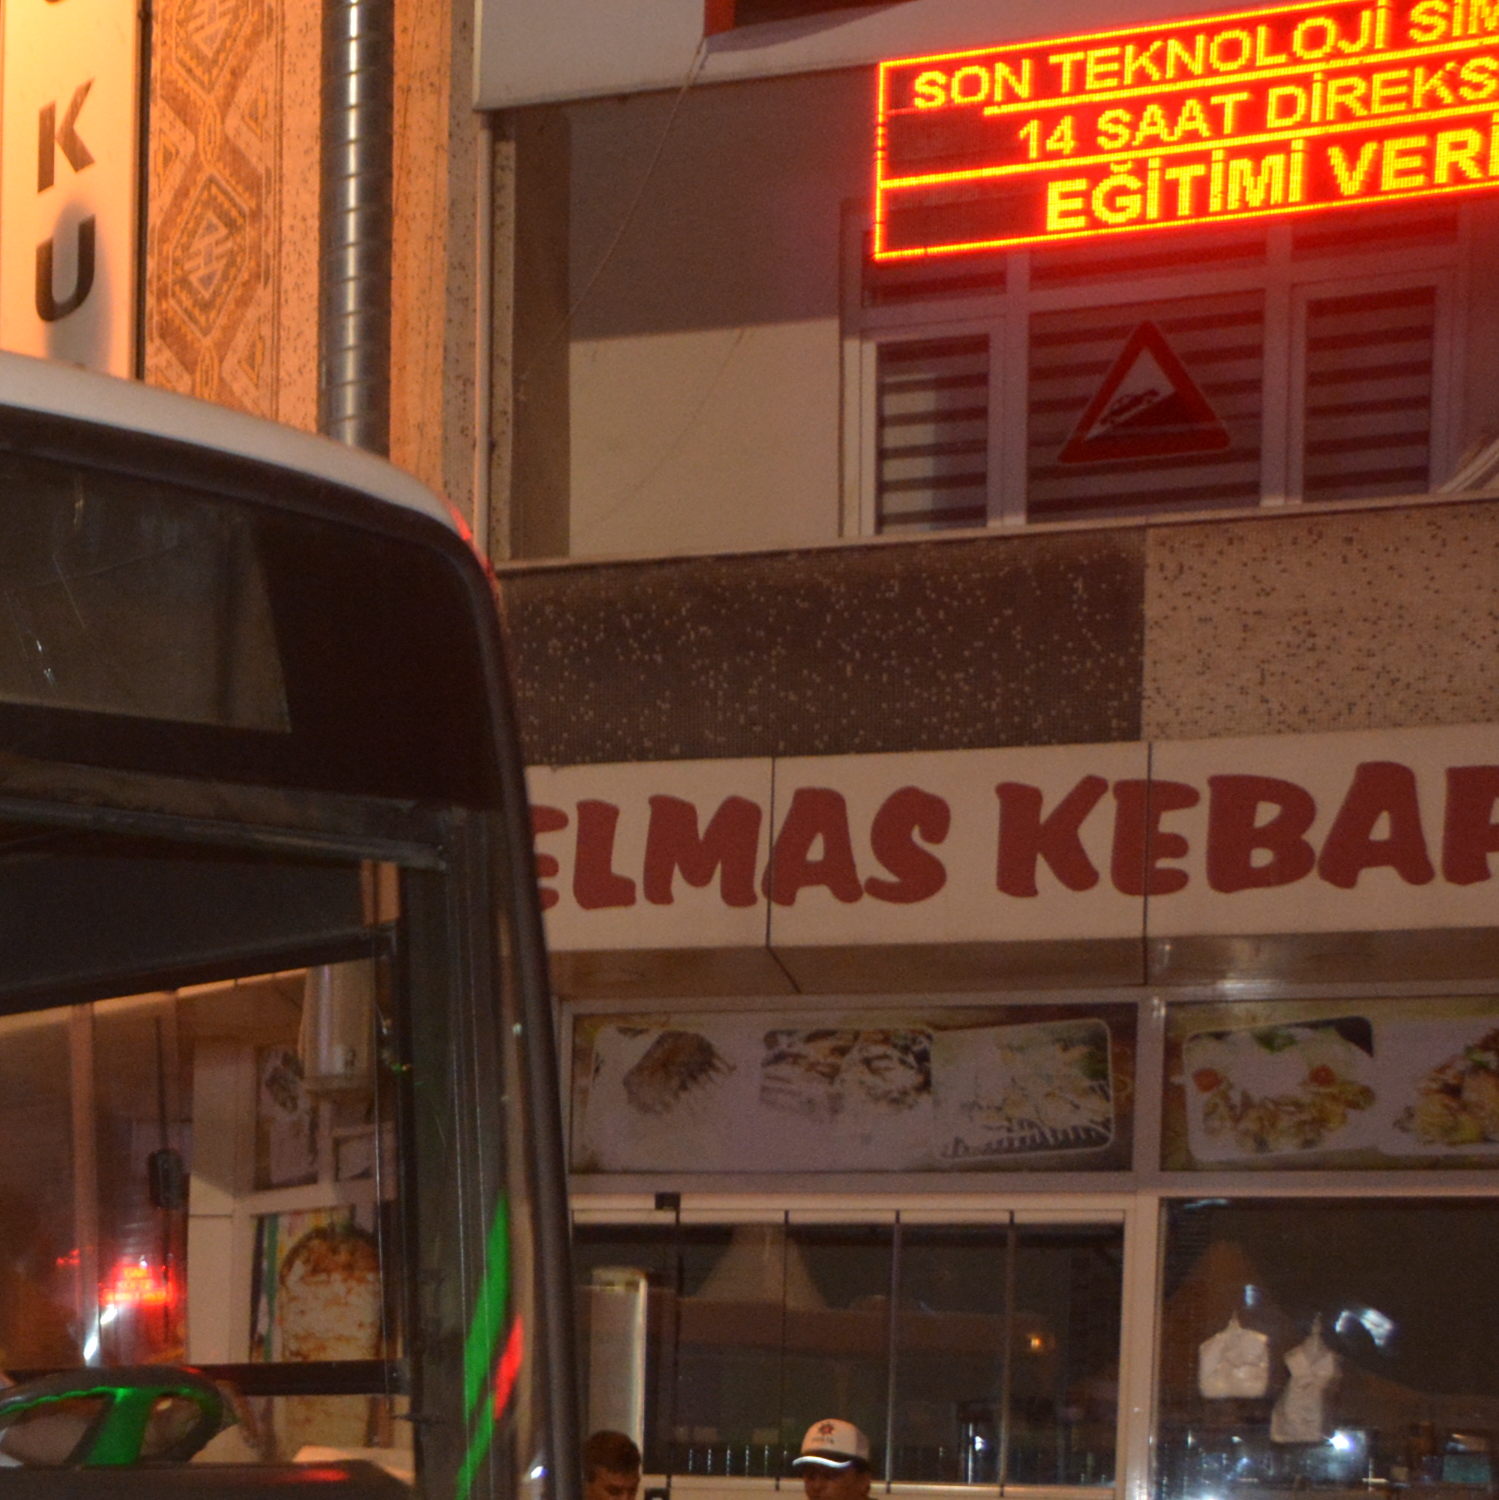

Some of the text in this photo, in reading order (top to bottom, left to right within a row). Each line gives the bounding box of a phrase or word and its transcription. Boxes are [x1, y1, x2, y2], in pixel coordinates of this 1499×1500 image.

[914, 58, 1031, 110] SON
[1049, 0, 1391, 93] TEKNOLOJİ
[1018, 56, 1499, 159] 14 SAAT DİREKS
[1046, 139, 1305, 232] EĞİTİMİ
